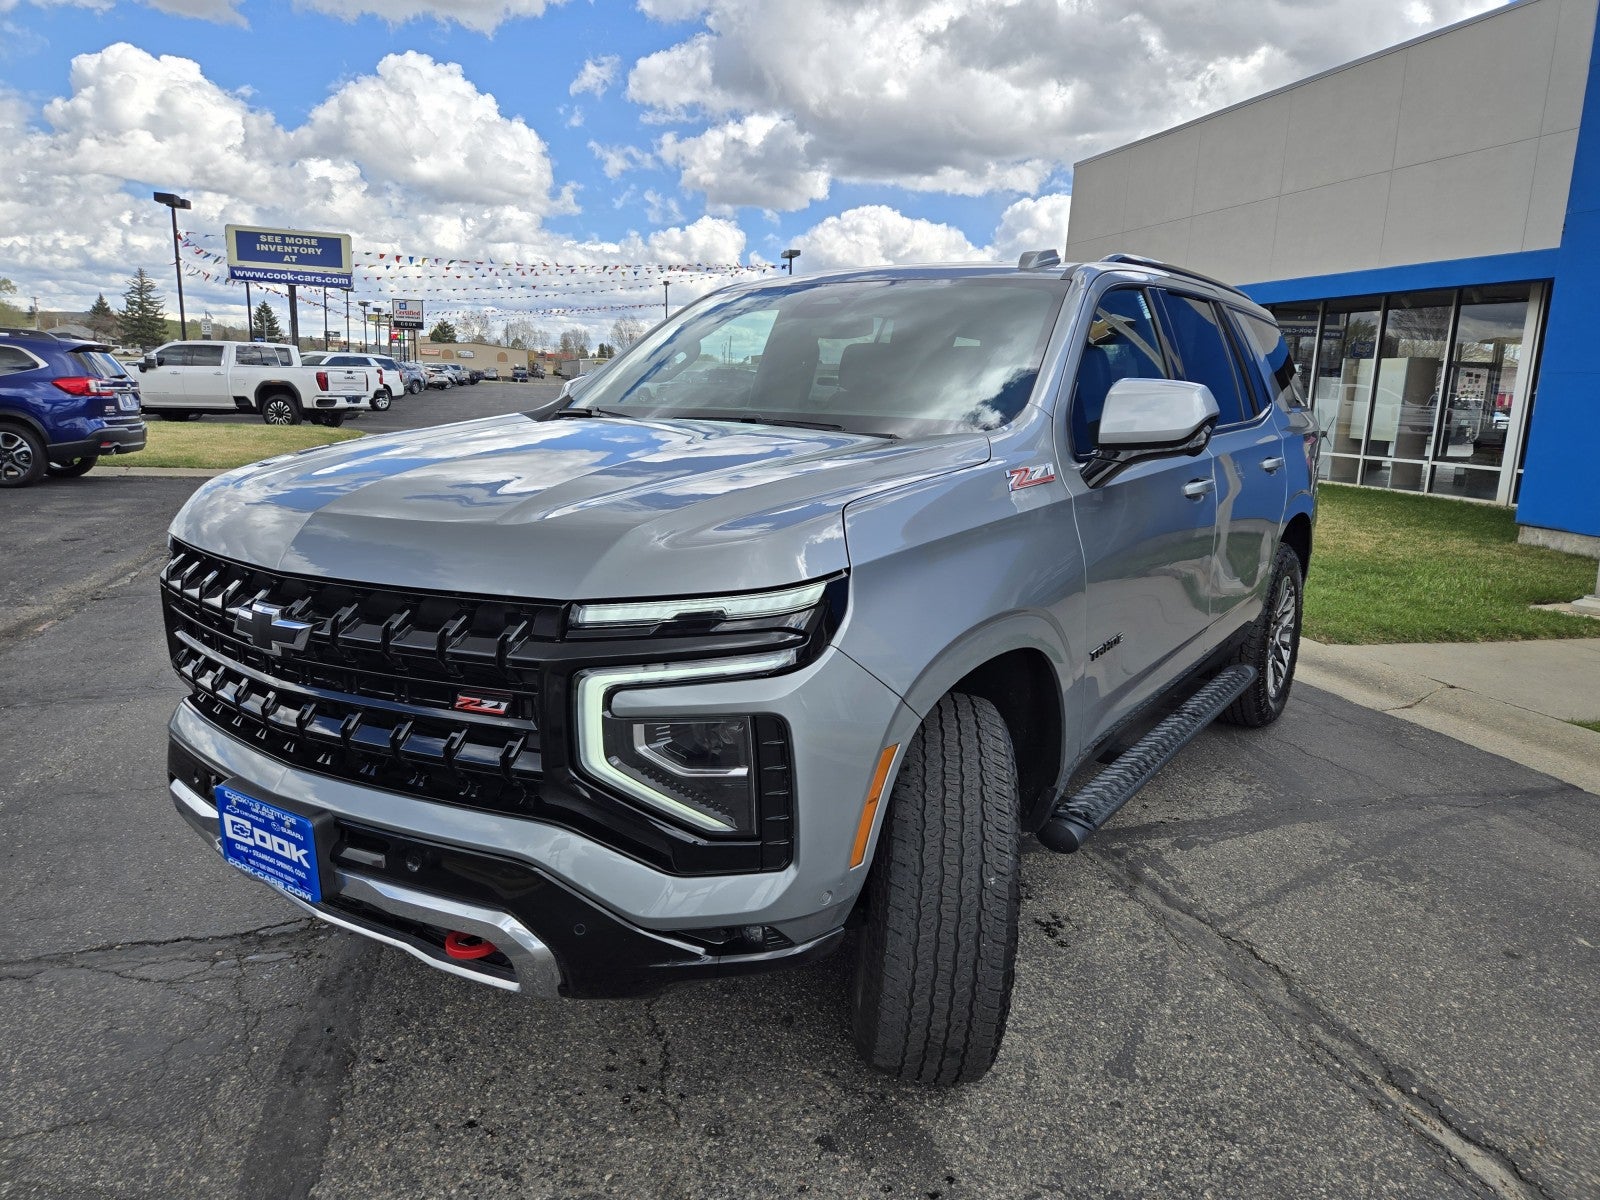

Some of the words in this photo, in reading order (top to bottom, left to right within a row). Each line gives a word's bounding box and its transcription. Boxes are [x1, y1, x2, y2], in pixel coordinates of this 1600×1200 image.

[260, 234, 282, 243] SEE
[285, 236, 318, 246] MORE
[256, 243, 323, 255] INVENTORY
[283, 255, 298, 263] AT
[234, 270, 349, 285] www.cook-cars.com
[395, 309, 421, 317] Certified
[1005, 462, 1056, 492] Z71
[454, 693, 510, 715] Z71
[223, 812, 311, 869] COOK
[280, 826, 304, 841] SUBARU
[228, 858, 312, 902] COOK-CARS.COM
